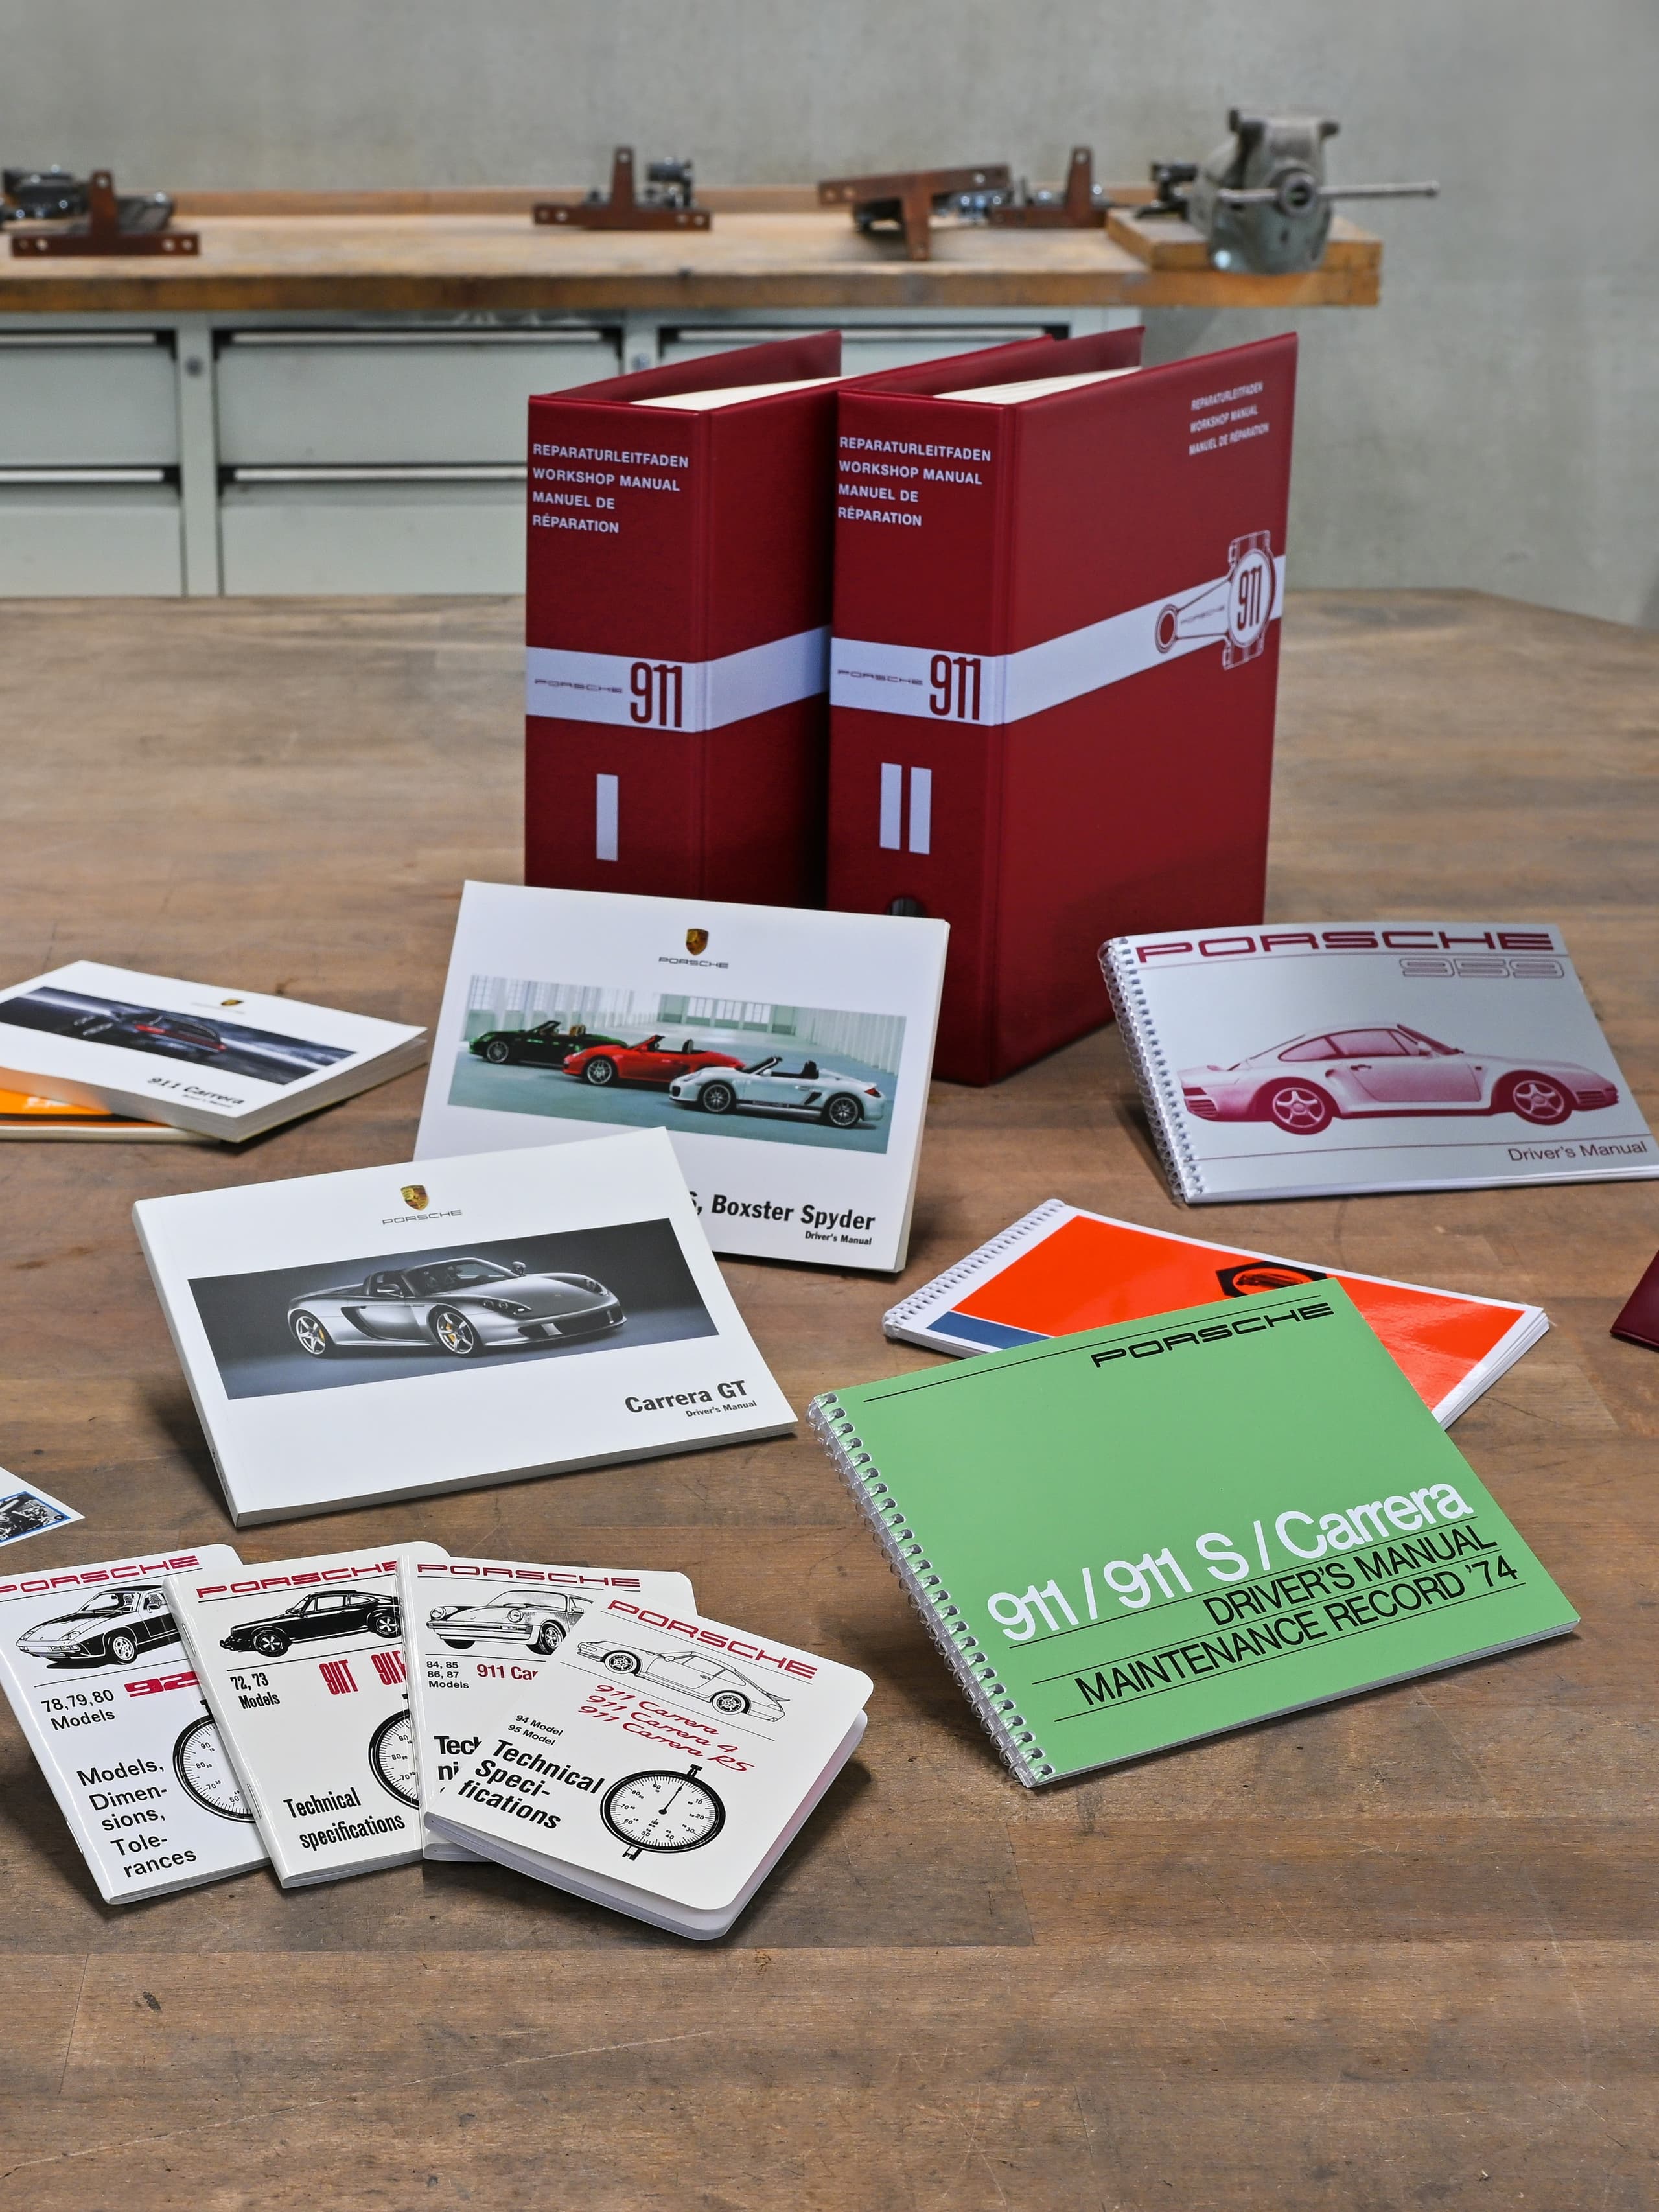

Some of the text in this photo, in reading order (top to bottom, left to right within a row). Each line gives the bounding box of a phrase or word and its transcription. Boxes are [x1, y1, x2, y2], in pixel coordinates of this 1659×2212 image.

[1190, 404, 1259, 434] WORKSHOP MANUAL
[533, 443, 689, 468] REPARATURLEITFADEN
[839, 436, 992, 461] REPARATURLEITFADEN
[1189, 437, 1217, 456] MANUEL
[1218, 434, 1228, 447] DE
[532, 467, 680, 491] WORKSHOP MANUAL
[839, 460, 982, 485] WORKSHOP MANUAL
[532, 491, 615, 509] MANUEL DE
[838, 483, 918, 503] MANUEL DE
[532, 513, 619, 533] RÉPARATION
[837, 506, 922, 527] RÉPARATION
[1237, 565, 1262, 631] 911
[534, 662, 682, 728] PORSCHE 911
[837, 654, 981, 721] PORSCHE 911
[1136, 931, 1554, 963] PORSCHE
[658, 957, 728, 969] PORSCHE
[1399, 957, 1564, 979] 959
[147, 1078, 181, 1089] 911
[183, 1086, 244, 1104] Carrera
[1508, 1141, 1648, 1161] Driver's Manual
[382, 1209, 463, 1225] PORSCHE
[712, 1194, 794, 1222] Boxster
[800, 1204, 876, 1230] Spyder
[805, 1230, 872, 1246] Driver's Manual
[1091, 1302, 1334, 1368] PORSCHE
[625, 1380, 747, 1413] Carrera GT
[686, 1400, 757, 1417] Driver's Manual
[987, 1579, 1079, 1641] 911
[1103, 1548, 1194, 1609] 911
[1196, 1532, 1249, 1582] S
[1275, 1483, 1474, 1559] Carrera
[417, 1564, 641, 1588] PORSCHE
[1203, 1524, 1498, 1626] DRIVER'S MANUAL
[607, 1600, 817, 1679] PORSCHE
[1074, 1555, 1518, 1705] MAINTENANCE RECORD '74
[426, 1661, 443, 1670] 84,
[427, 1670, 444, 1679] 86,
[476, 1664, 505, 1679] 911
[230, 1672, 270, 1692] 72, 73
[428, 1681, 469, 1689] Models
[238, 1691, 281, 1710] Models
[594, 1684, 719, 1735] 911 Carrera
[50, 1709, 115, 1731] Models
[515, 1715, 564, 1736] 94 Model
[586, 1695, 628, 1711] 911
[631, 1712, 712, 1746] Carrera
[507, 1724, 557, 1746] 95 Model
[578, 1706, 755, 1772] 911 Carrera RS
[76, 1758, 165, 1787] Models,
[475, 1760, 550, 1797] Speci-
[493, 1739, 605, 1795] Technical
[89, 1786, 168, 1811] Dimen-
[283, 1787, 362, 1819] Technical
[458, 1780, 561, 1829] fications
[101, 1808, 166, 1832] sions,
[110, 1834, 168, 1856] Tole-
[299, 1815, 406, 1851] specifications
[123, 1850, 197, 1878] rances
